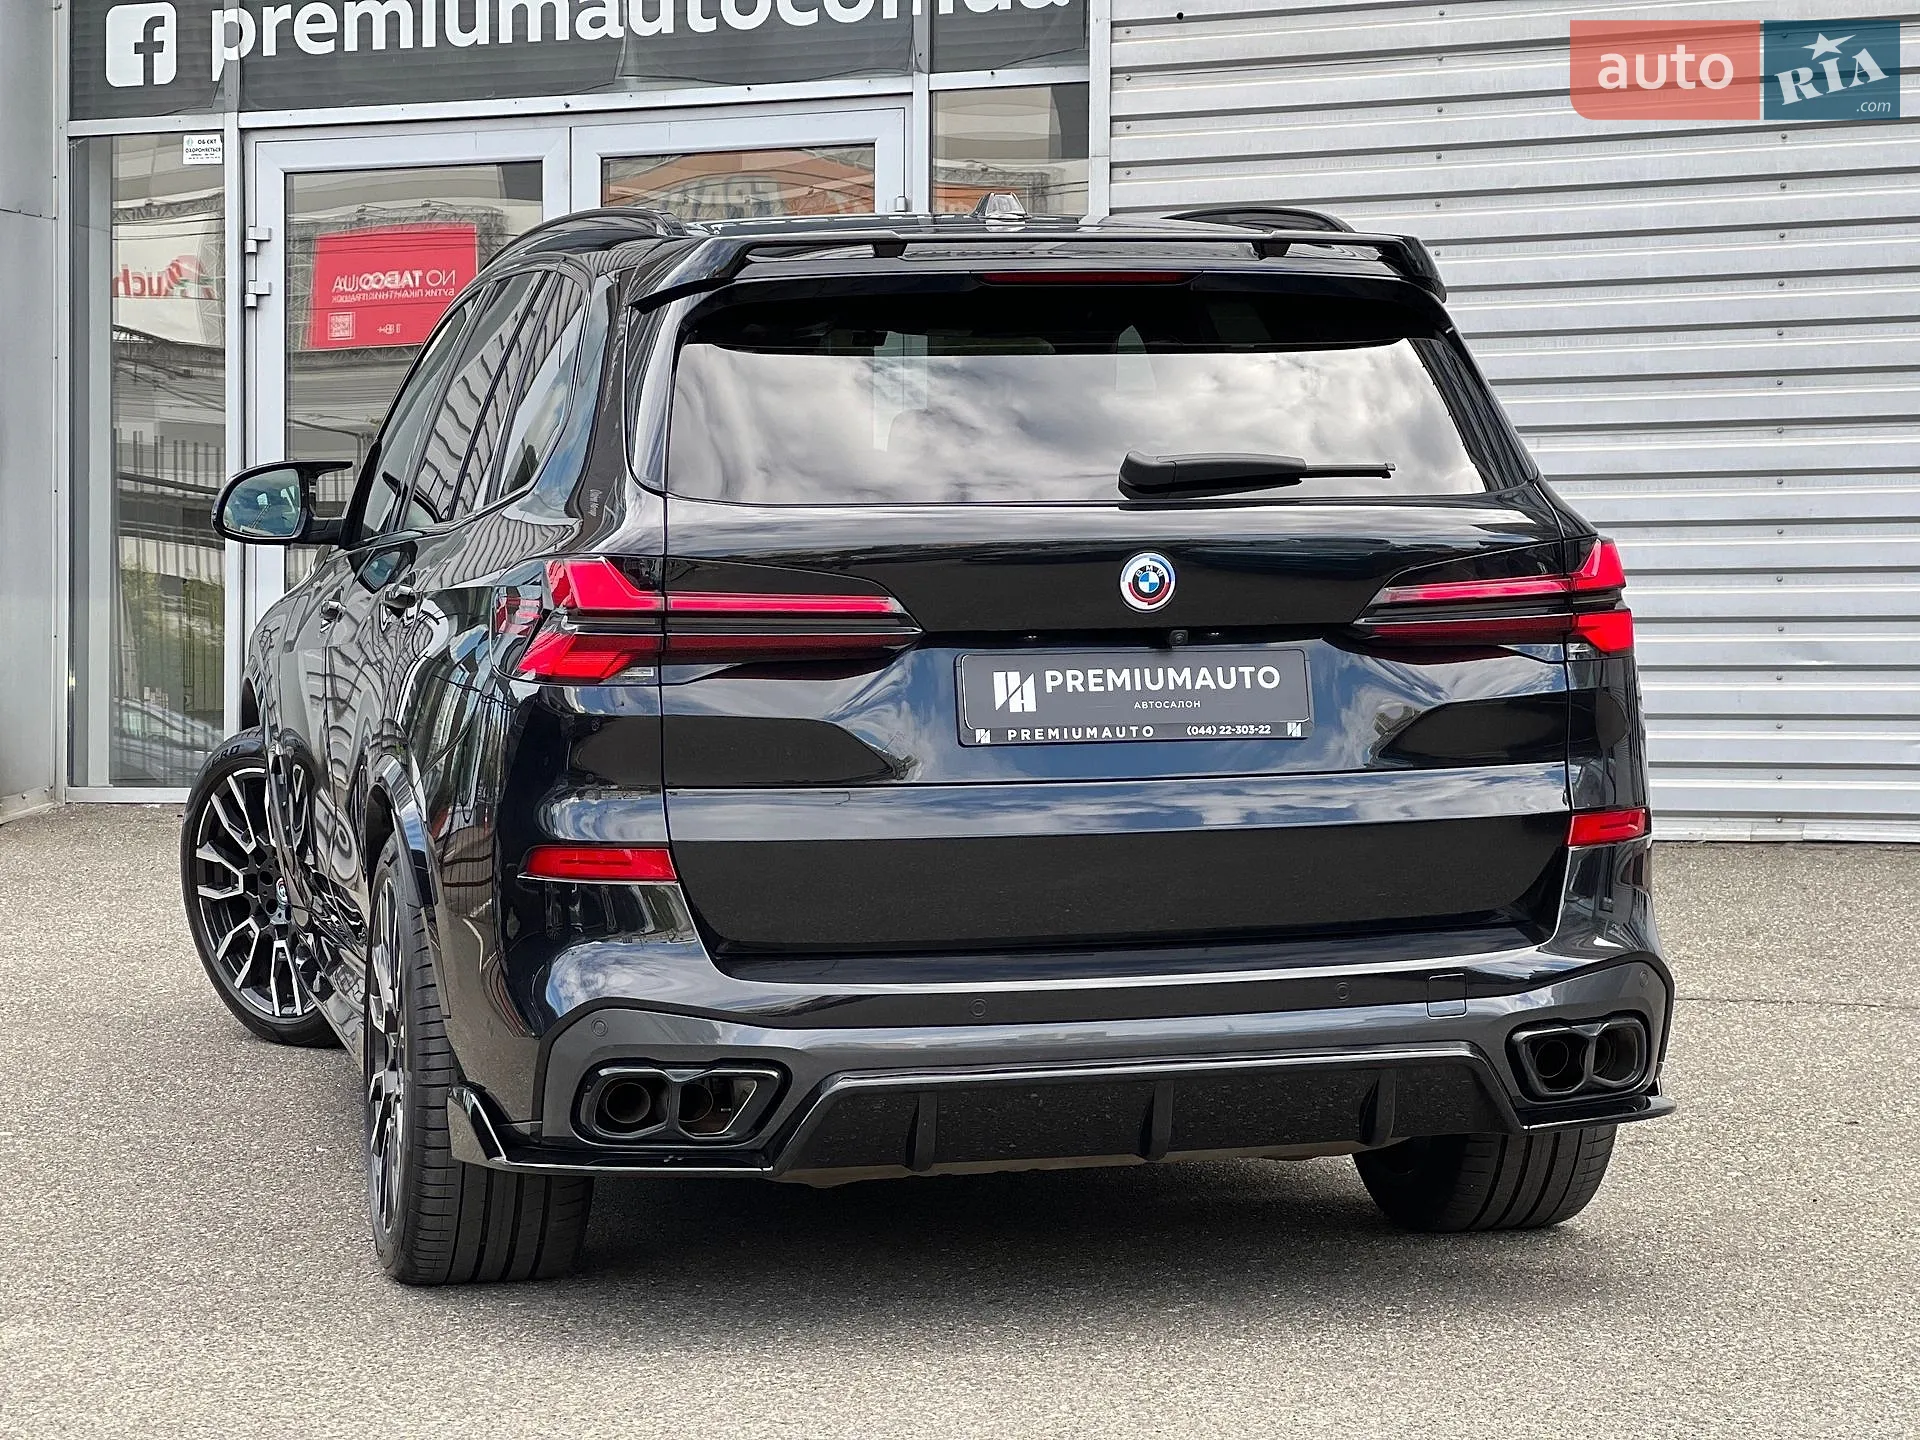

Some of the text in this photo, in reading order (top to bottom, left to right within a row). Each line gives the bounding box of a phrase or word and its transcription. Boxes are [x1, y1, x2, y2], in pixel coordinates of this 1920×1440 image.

[1135, 564, 1165, 578] BMW
[1045, 666, 1281, 692] PREMIUMAUTO
[1133, 700, 1201, 710] АВТОСАЛОН
[1007, 724, 1272, 741] PREMIUMAUTO (044) 22-303-22
